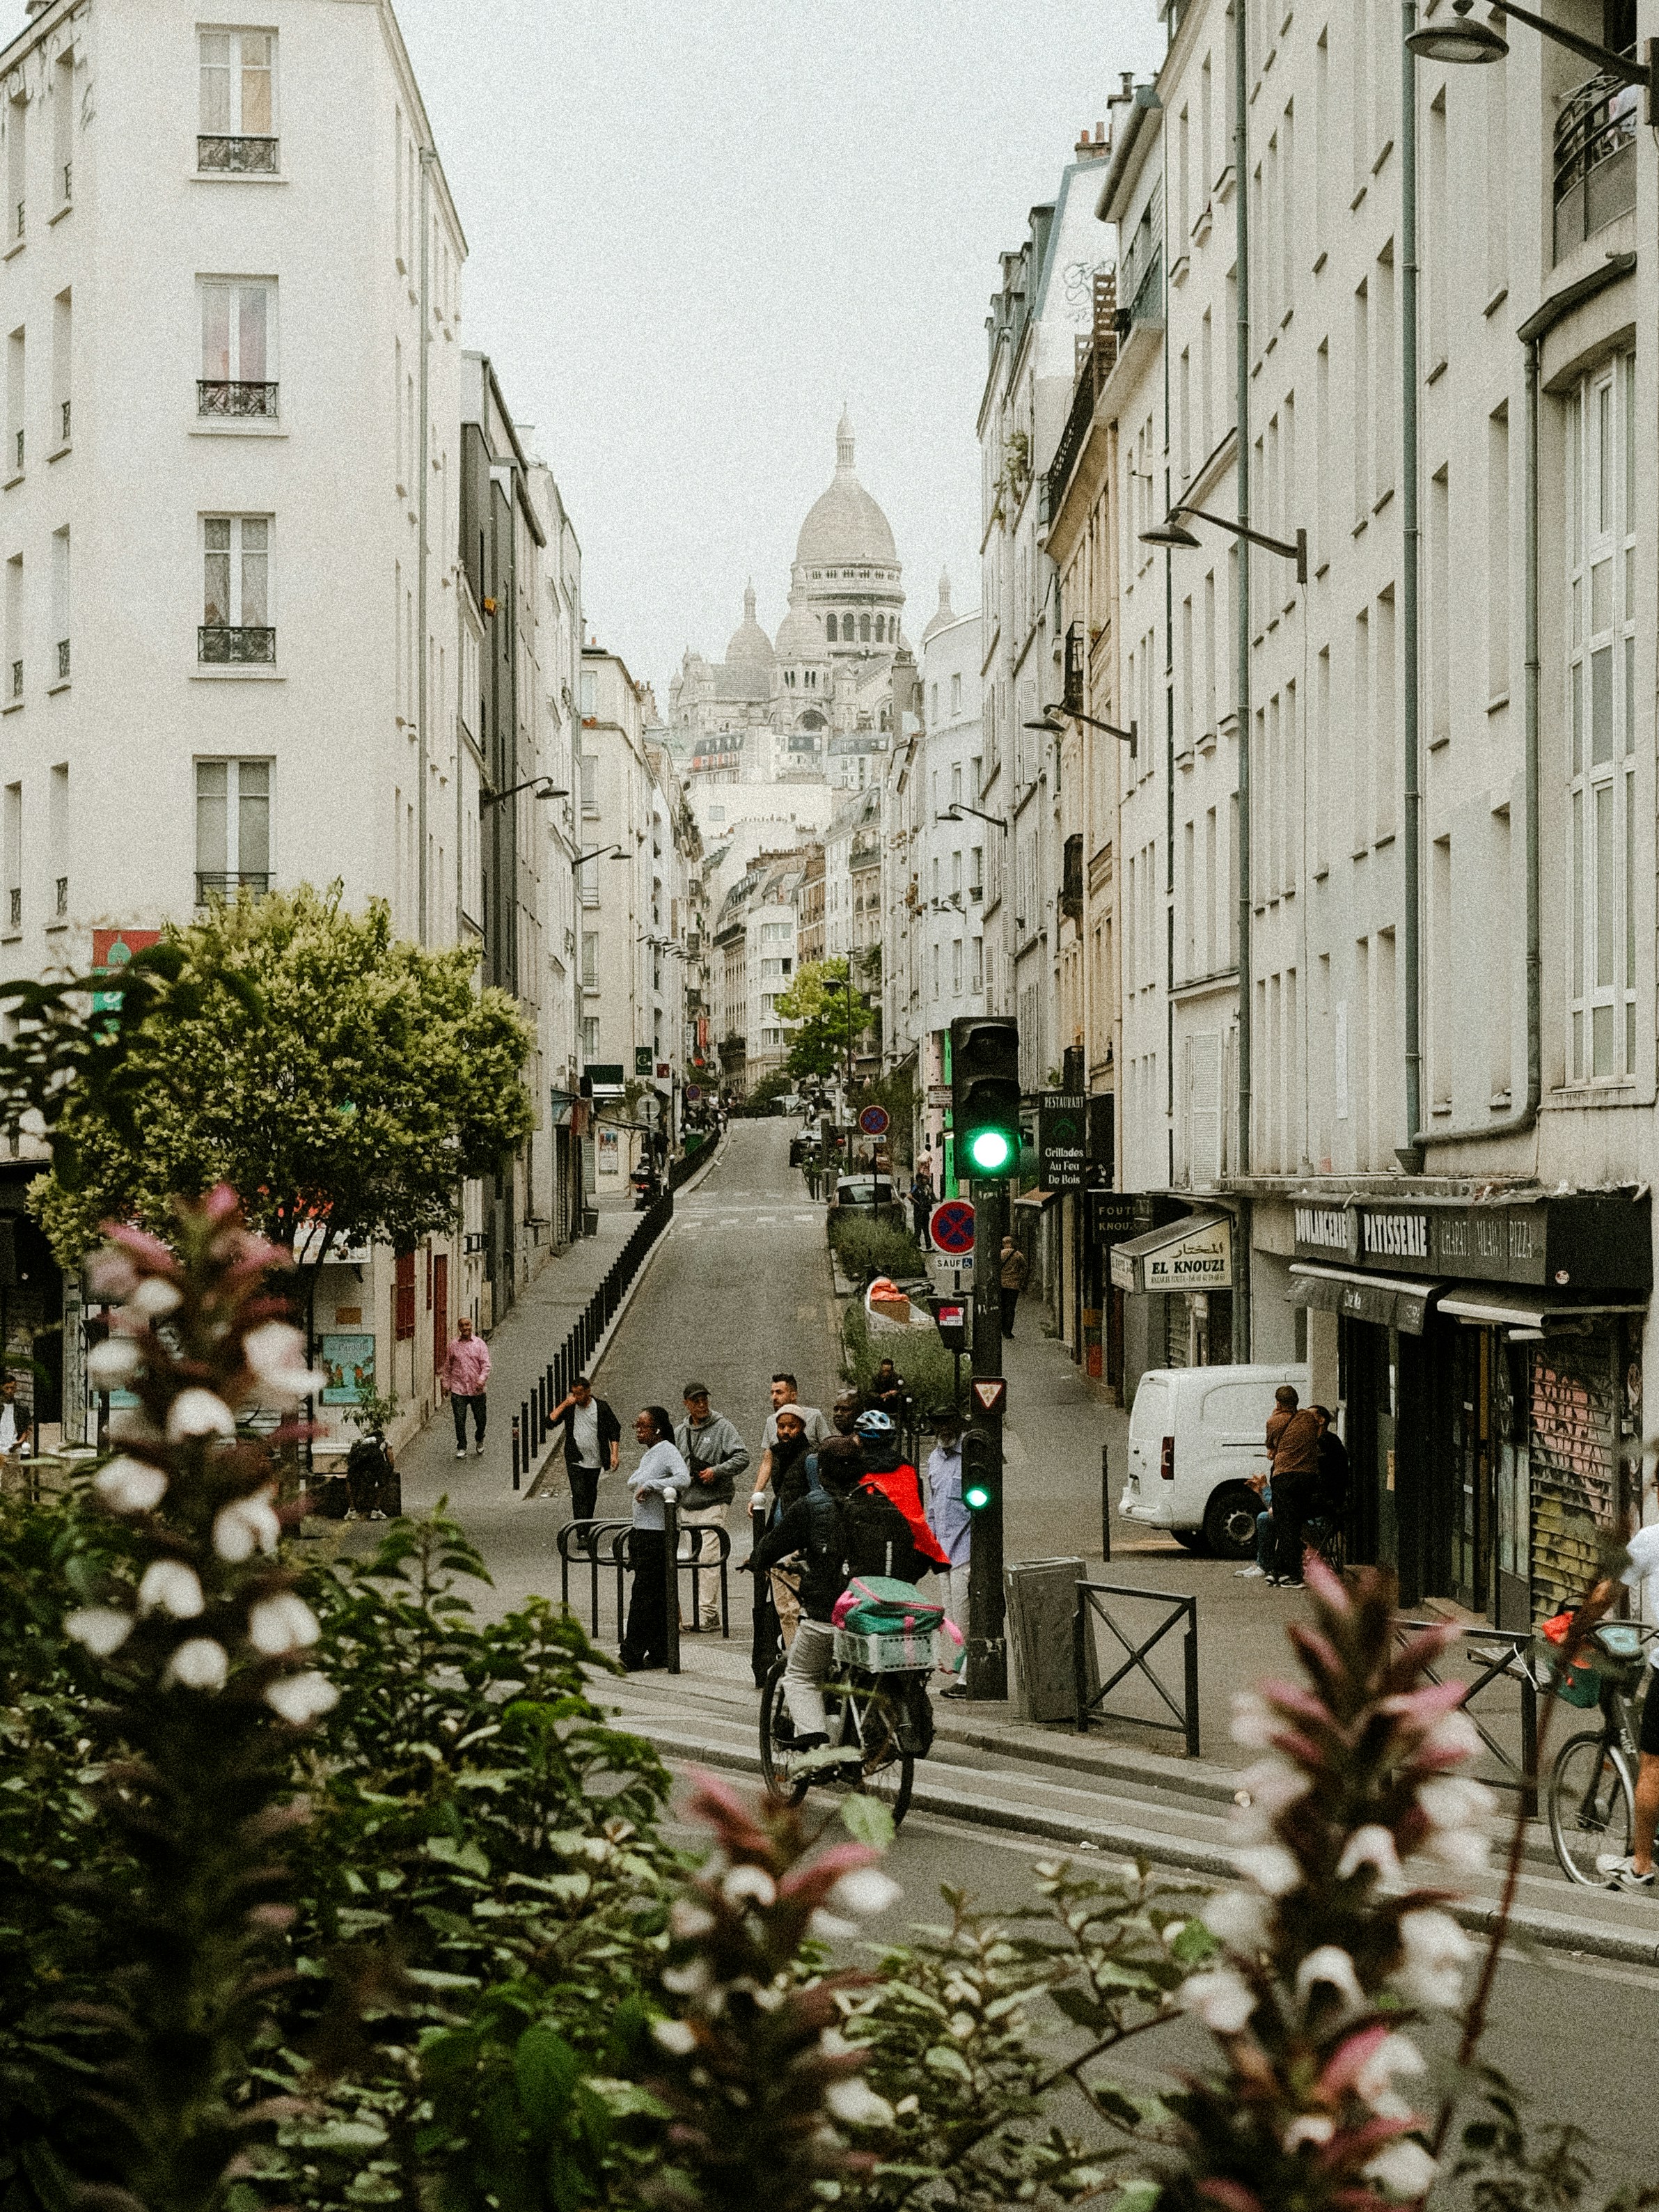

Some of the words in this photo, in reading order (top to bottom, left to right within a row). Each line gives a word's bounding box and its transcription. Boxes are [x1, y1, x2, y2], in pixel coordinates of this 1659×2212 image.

[1044, 1097, 1084, 1108] RESTAURANT
[1045, 1147, 1084, 1157] Grillades
[1050, 1161, 1062, 1171] Au
[1064, 1161, 1080, 1171] Feu
[1048, 1175, 1060, 1184] De
[1062, 1175, 1080, 1184] Bois
[1099, 1222, 1133, 1231] KNOU
[1295, 1208, 1347, 1248] BOULANGERIE
[1364, 1214, 1427, 1257] PATISSERIE
[1509, 1221, 1532, 1258] PIZZA
[1152, 1262, 1168, 1275] EL
[1174, 1259, 1225, 1273] KNOUZI
